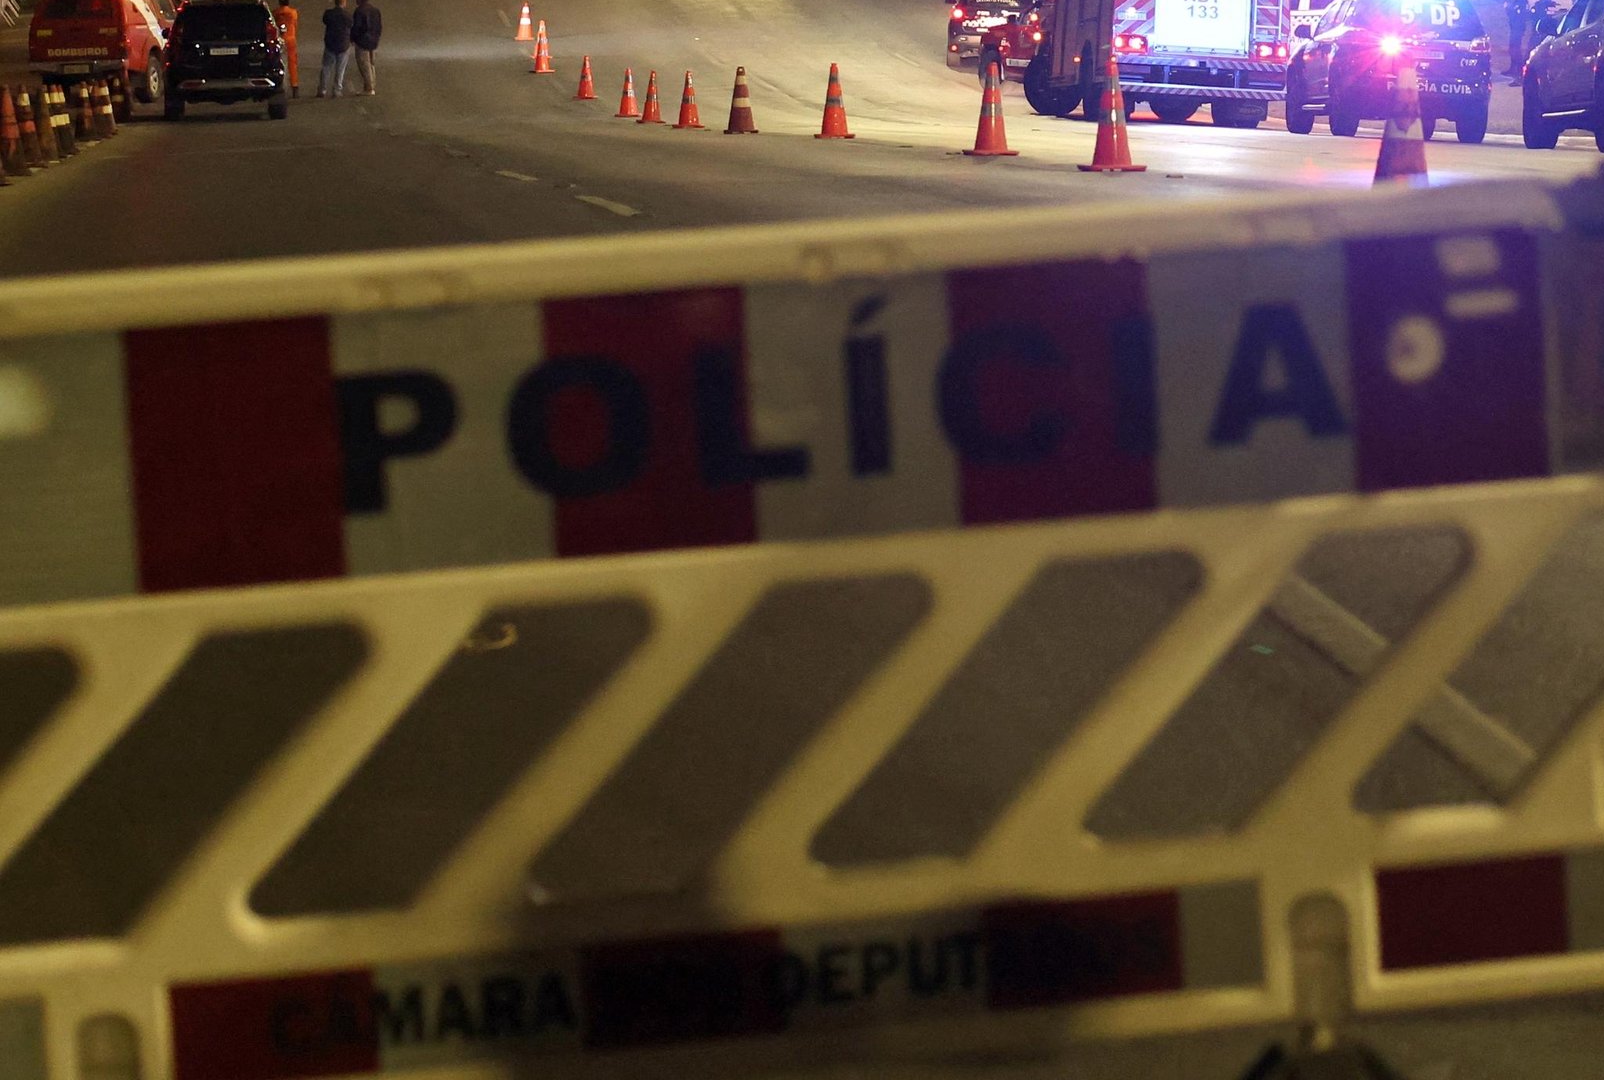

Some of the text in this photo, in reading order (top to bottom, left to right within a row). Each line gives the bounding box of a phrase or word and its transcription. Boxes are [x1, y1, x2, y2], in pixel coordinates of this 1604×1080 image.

[1187, 5, 1220, 19] 133
[1430, 3, 1461, 27] DP
[47, 47, 109, 56] BOMBEIROS
[1441, 83, 1472, 94] CIVIL
[334, 295, 1350, 514] POLÍCIA
